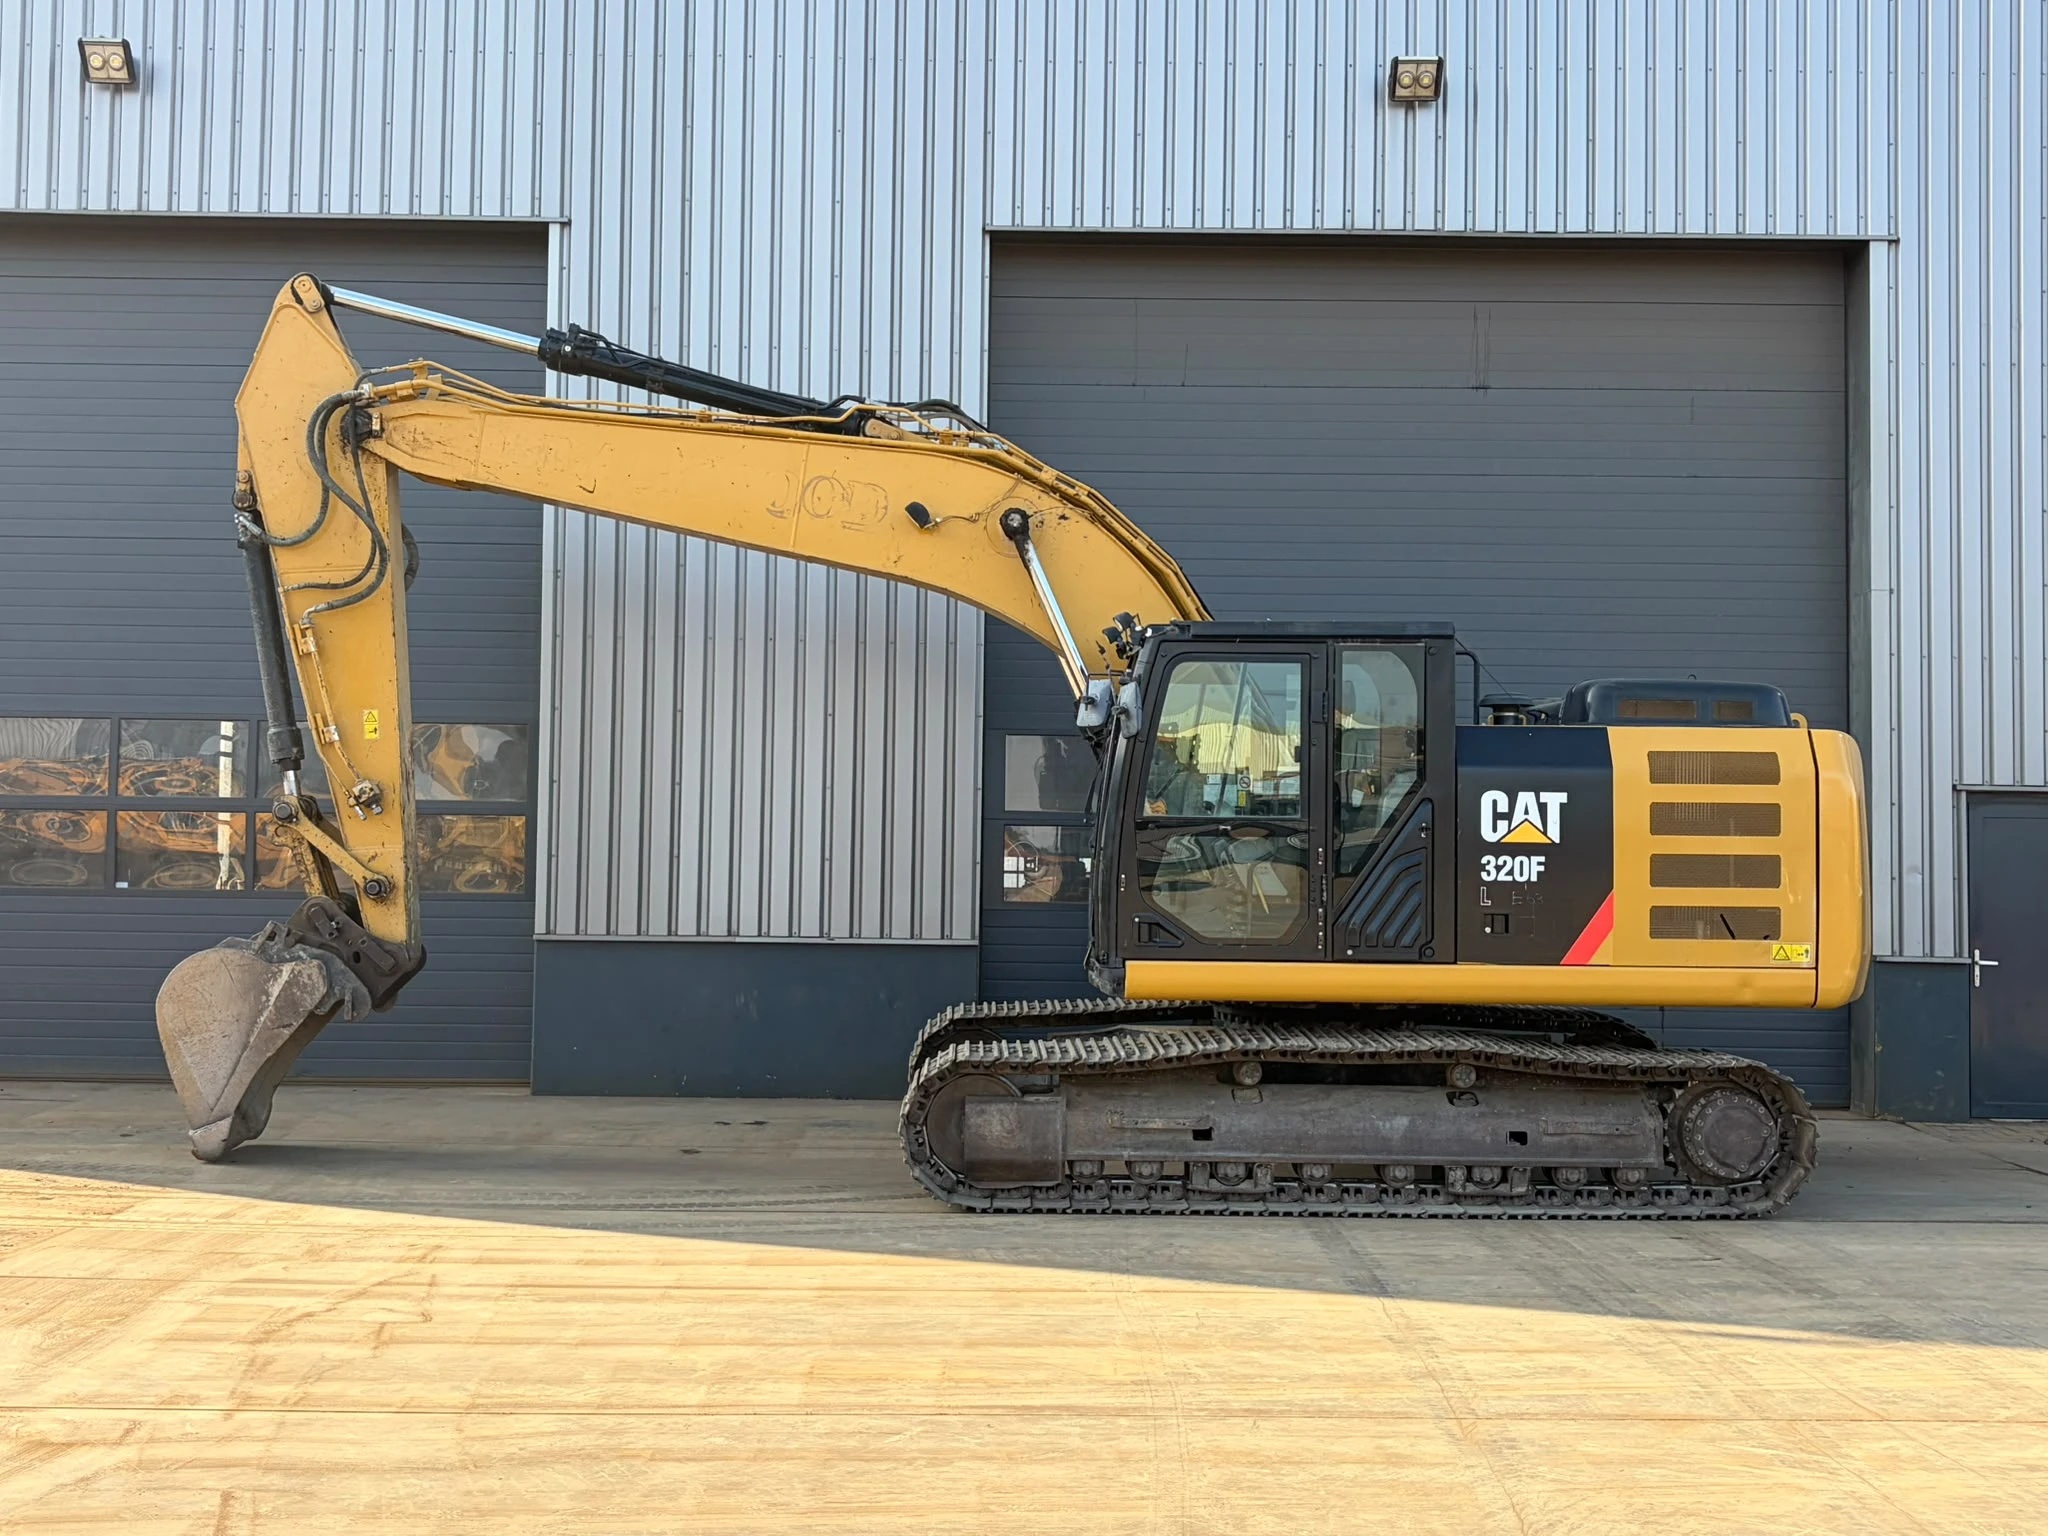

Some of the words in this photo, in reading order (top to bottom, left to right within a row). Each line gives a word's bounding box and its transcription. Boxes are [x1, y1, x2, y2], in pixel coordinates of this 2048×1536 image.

[1480, 790, 1568, 844] CAT
[1480, 855, 1546, 882] 320F
[1480, 886, 1492, 906] L
